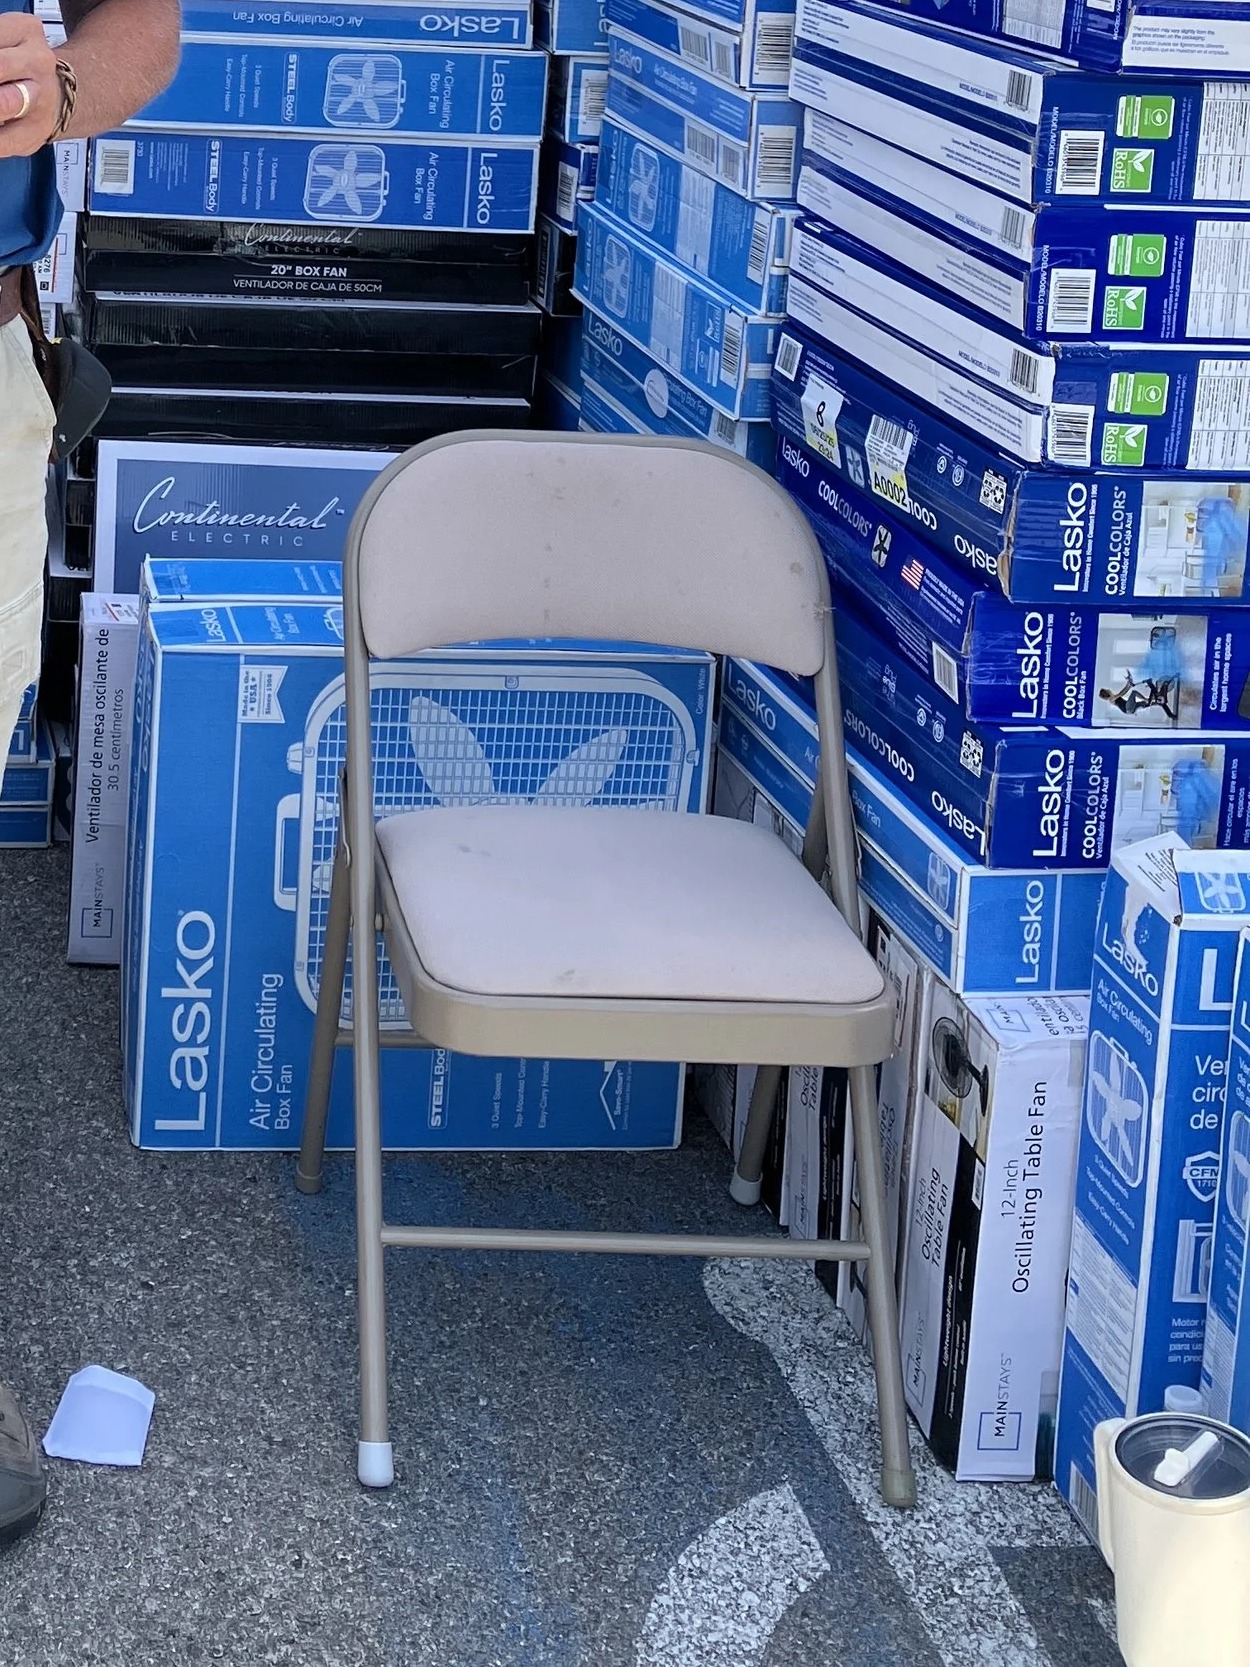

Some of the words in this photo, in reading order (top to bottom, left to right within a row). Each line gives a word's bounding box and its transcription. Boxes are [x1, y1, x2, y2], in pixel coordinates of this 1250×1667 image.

[232, 10, 254, 22] Fan
[257, 11, 282, 24] Box
[284, 13, 345, 28] Circulating
[347, 16, 364, 28] Air
[419, 13, 520, 40] Lasko
[444, 59, 455, 75] Air
[613, 39, 643, 74] Lasko
[439, 75, 454, 129] Circulating
[488, 59, 510, 132] Lasko
[428, 151, 439, 166] Air
[1114, 150, 1128, 190] RoHS
[424, 167, 439, 221] Circulating
[477, 152, 498, 225] Lasko
[244, 222, 360, 247] Continental
[233, 279, 294, 290] VENTILADOR
[296, 281, 310, 291] DE
[310, 281, 337, 292] CAJA
[339, 283, 352, 292] DE
[353, 283, 383, 293] 50CM
[270, 264, 293, 276] 20"
[295, 266, 320, 277] BOX
[323, 267, 348, 278] FAN
[1106, 287, 1120, 327] RoHS
[1103, 425, 1118, 465] RoHS
[133, 476, 340, 534] Continental
[781, 436, 810, 478] Lasko
[818, 480, 870, 537] COOLCOLORS
[874, 471, 906, 506] A0002
[170, 530, 304, 547] ELECTRIC
[1053, 482, 1088, 592] Lasko
[1105, 486, 1127, 595] COOLCOLORS
[95, 628, 109, 646] de
[202, 608, 226, 643] Lasko
[1011, 611, 1044, 719] Lasko
[1062, 612, 1083, 719] COOLCOLORS
[1224, 633, 1233, 661] spaces
[94, 649, 108, 710] oscilante
[1079, 670, 1087, 687] Fan
[1209, 665, 1220, 711] Circulates
[1222, 661, 1230, 685] home
[241, 700, 249, 718] Made
[249, 683, 257, 705] USA
[1078, 686, 1086, 701] Box
[1219, 686, 1228, 713] largest
[93, 714, 105, 749] mesa
[843, 708, 915, 782] COOLCOLORS
[89, 751, 103, 769] de
[86, 770, 102, 844] Ventilador
[931, 790, 986, 856] Lasko
[1033, 749, 1065, 857] Lasko
[1082, 751, 1105, 859] COOLCOLORS
[1015, 880, 1045, 984] Lasko
[1102, 922, 1159, 997] Lasko
[154, 910, 216, 1132] Lasko
[252, 972, 285, 1089] Circulating
[1097, 978, 1110, 998] Air
[1108, 988, 1153, 1046] Circulating
[275, 1063, 292, 1094] Fan
[252, 1094, 271, 1131] Air
[275, 1099, 291, 1131] Box
[1027, 1081, 1048, 1117] Fan
[1189, 1109, 1218, 1130] de
[1022, 1124, 1044, 1182] Table
[915, 1176, 927, 1227] 12-Inch
[936, 1181, 949, 1216] Fan
[1001, 1159, 1019, 1218] 12-Inch
[921, 1166, 941, 1262] Oscillating
[930, 1217, 945, 1270] Table
[1011, 1188, 1043, 1293] Oscillating
[1171, 1318, 1199, 1327] Motor
[994, 1355, 1012, 1437] MAINSTAYS
